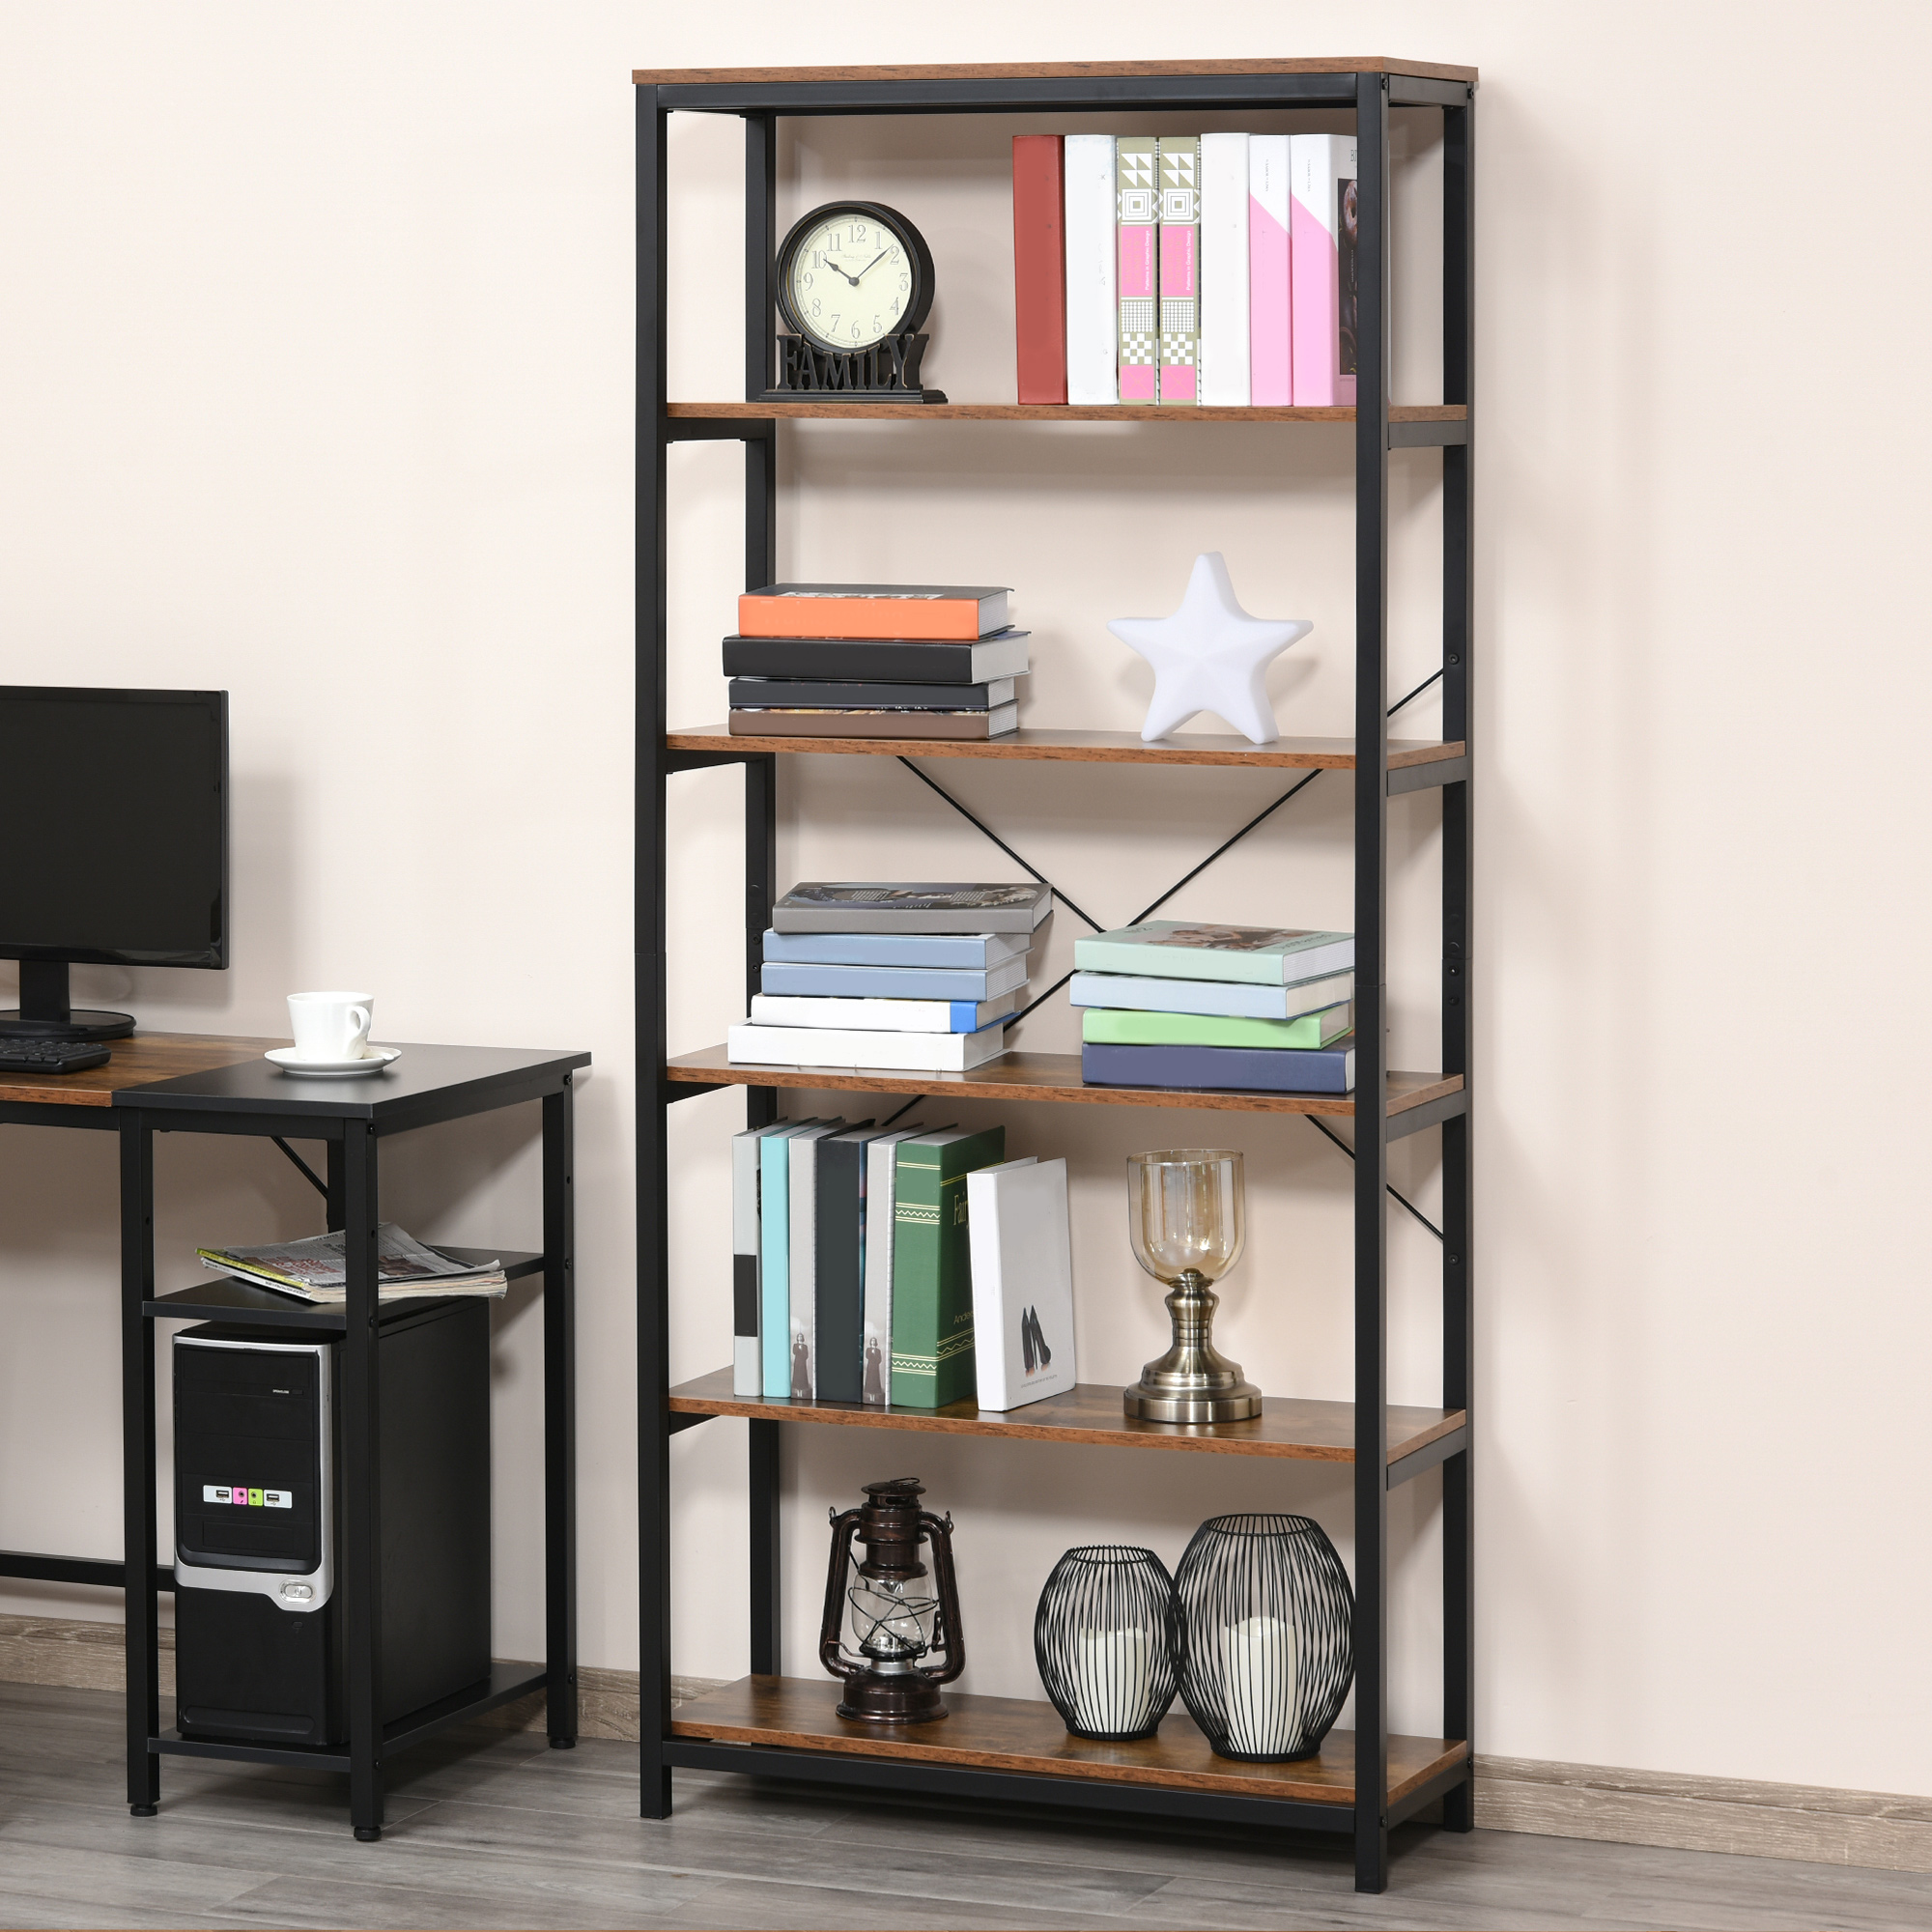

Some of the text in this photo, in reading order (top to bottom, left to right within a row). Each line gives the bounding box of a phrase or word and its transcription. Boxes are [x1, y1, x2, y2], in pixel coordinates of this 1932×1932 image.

[827, 233, 842, 252] 11
[848, 224, 867, 243] 12
[874, 231, 883, 250] 1
[811, 249, 828, 270] 10
[890, 245, 900, 266] 2
[803, 271, 814, 291] 9
[898, 272, 909, 292] 3
[811, 298, 822, 318] 8
[889, 297, 899, 316] 4
[831, 314, 841, 333] 7
[851, 320, 861, 340] 6
[872, 314, 883, 334] 5
[777, 334, 916, 389] FAMILY
